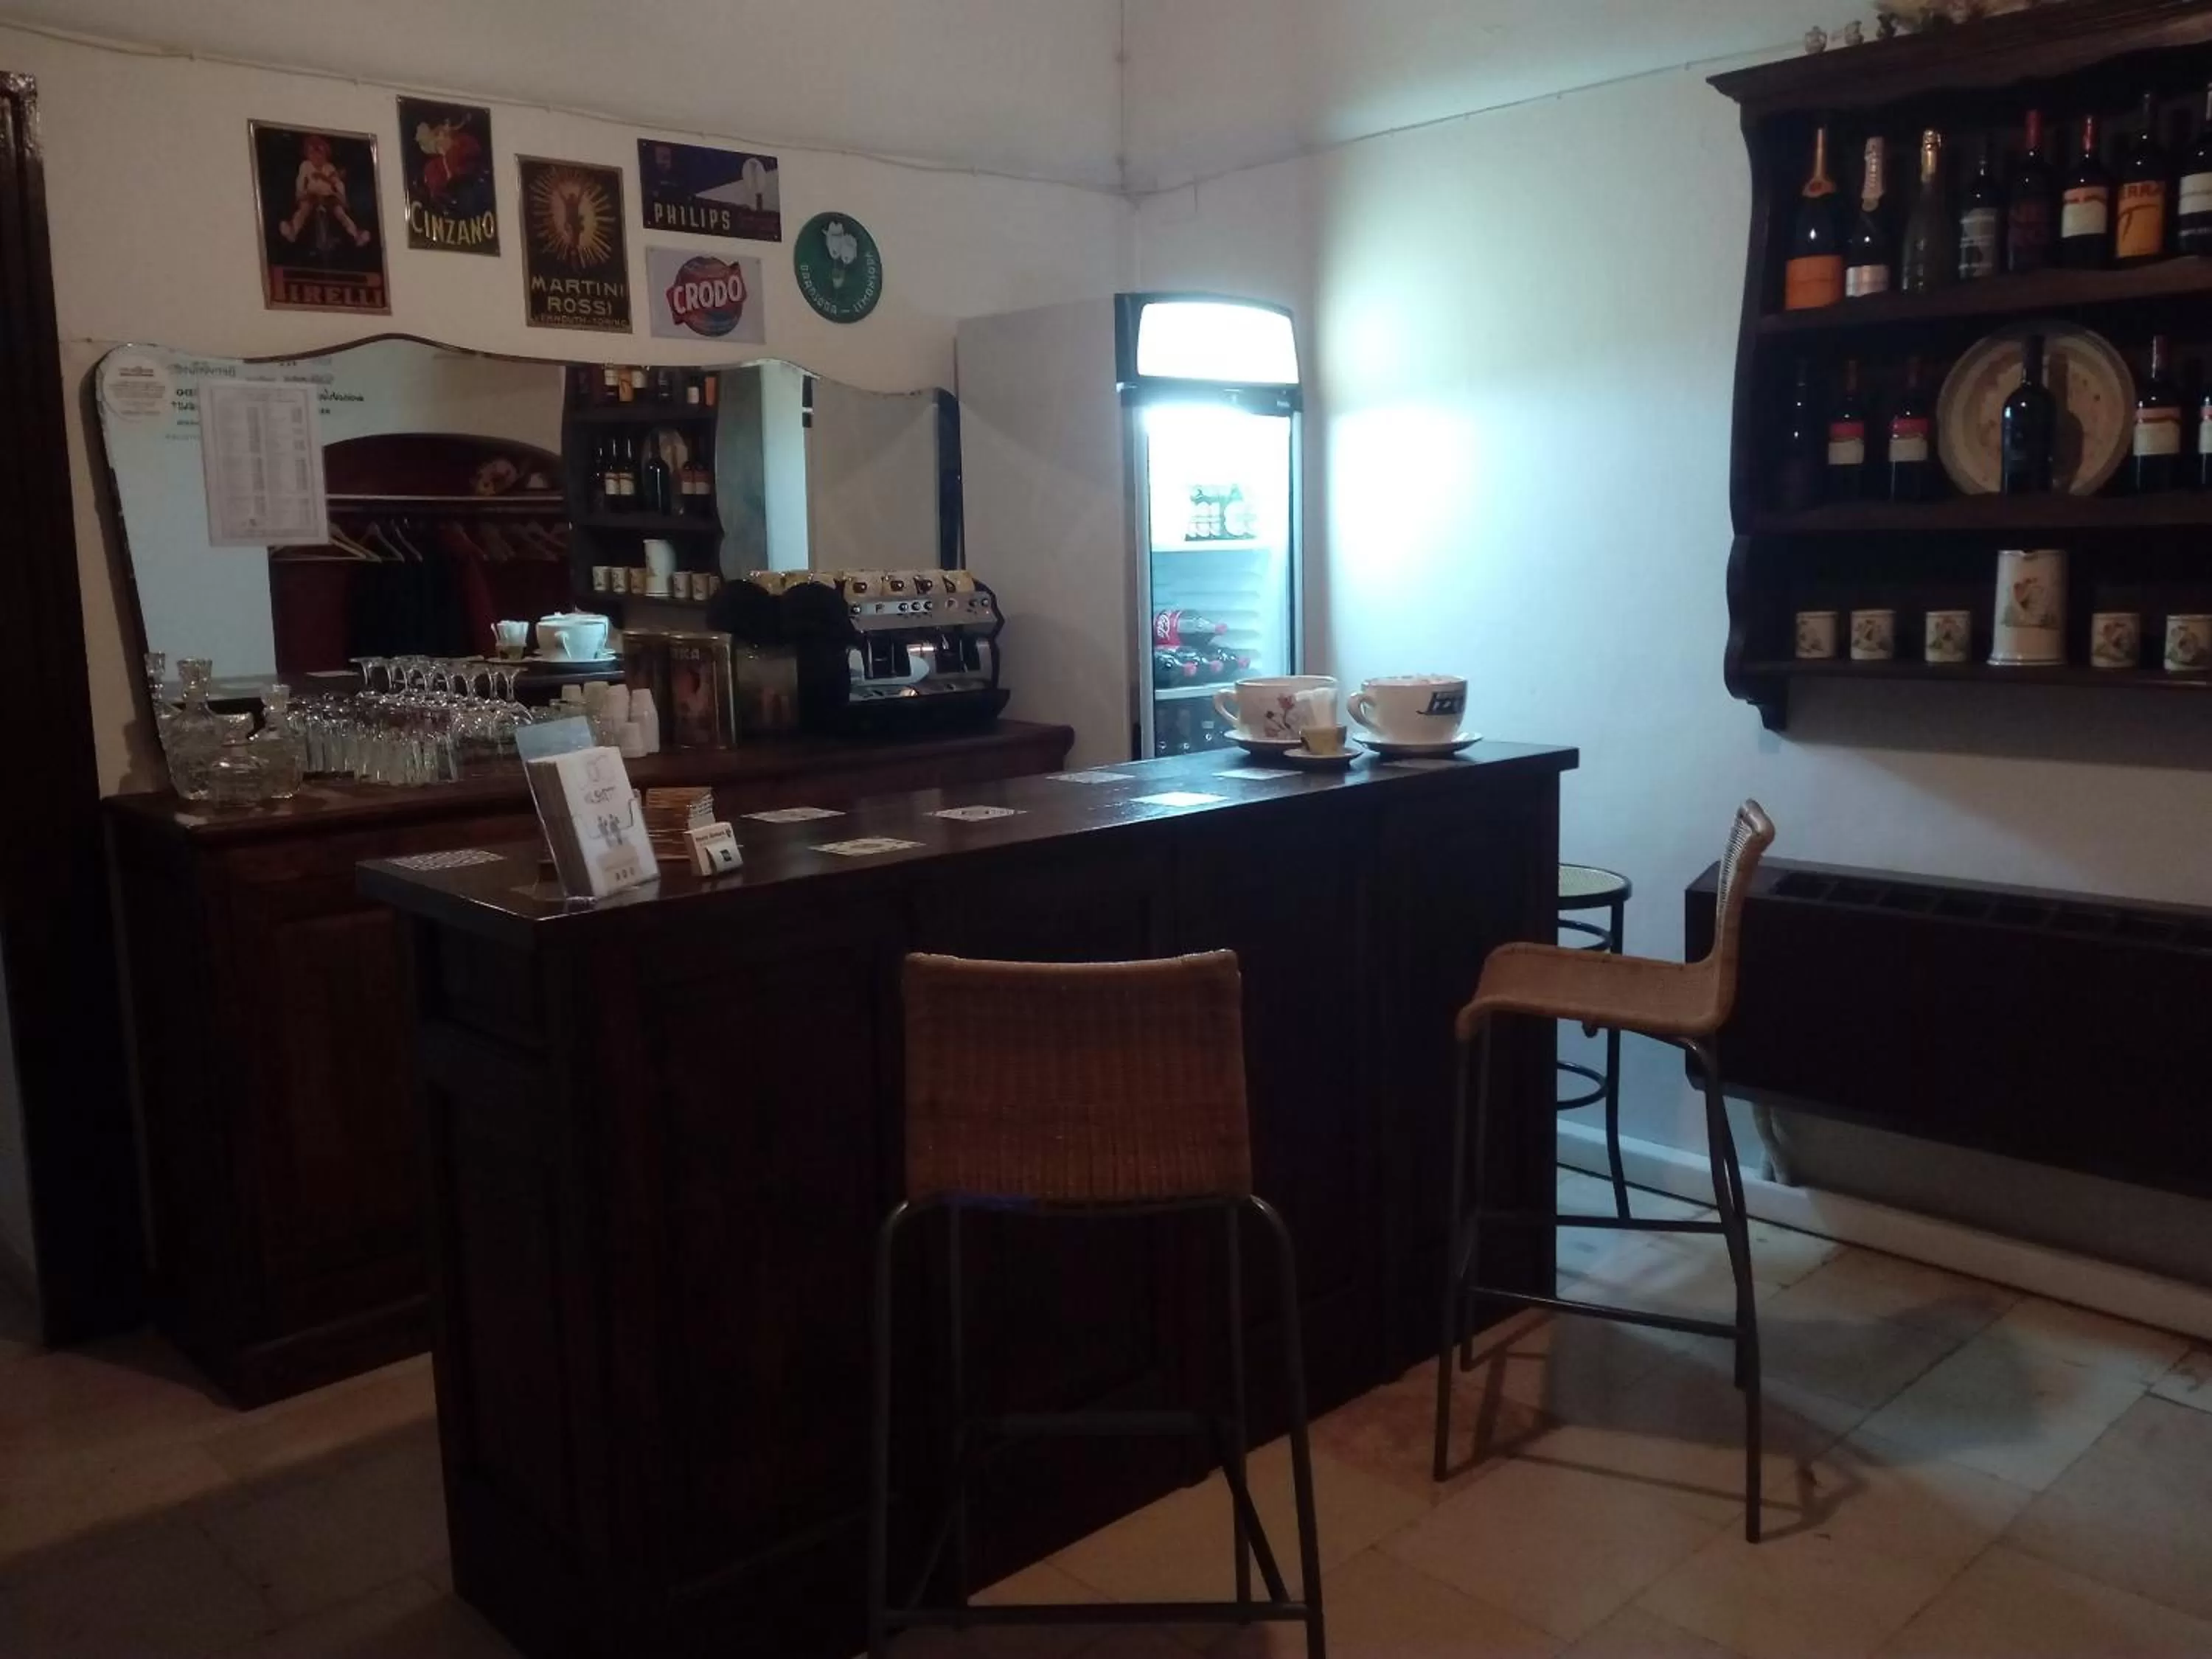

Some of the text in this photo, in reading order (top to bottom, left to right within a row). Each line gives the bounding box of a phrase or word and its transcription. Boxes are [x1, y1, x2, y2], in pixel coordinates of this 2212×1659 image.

[411, 200, 495, 246] CINZANO
[653, 201, 731, 231] PHILIPS
[271, 263, 384, 307] PIRELLI
[531, 274, 625, 298] MARTINI
[672, 274, 742, 315] CRODO
[547, 296, 613, 316] ROSSI
